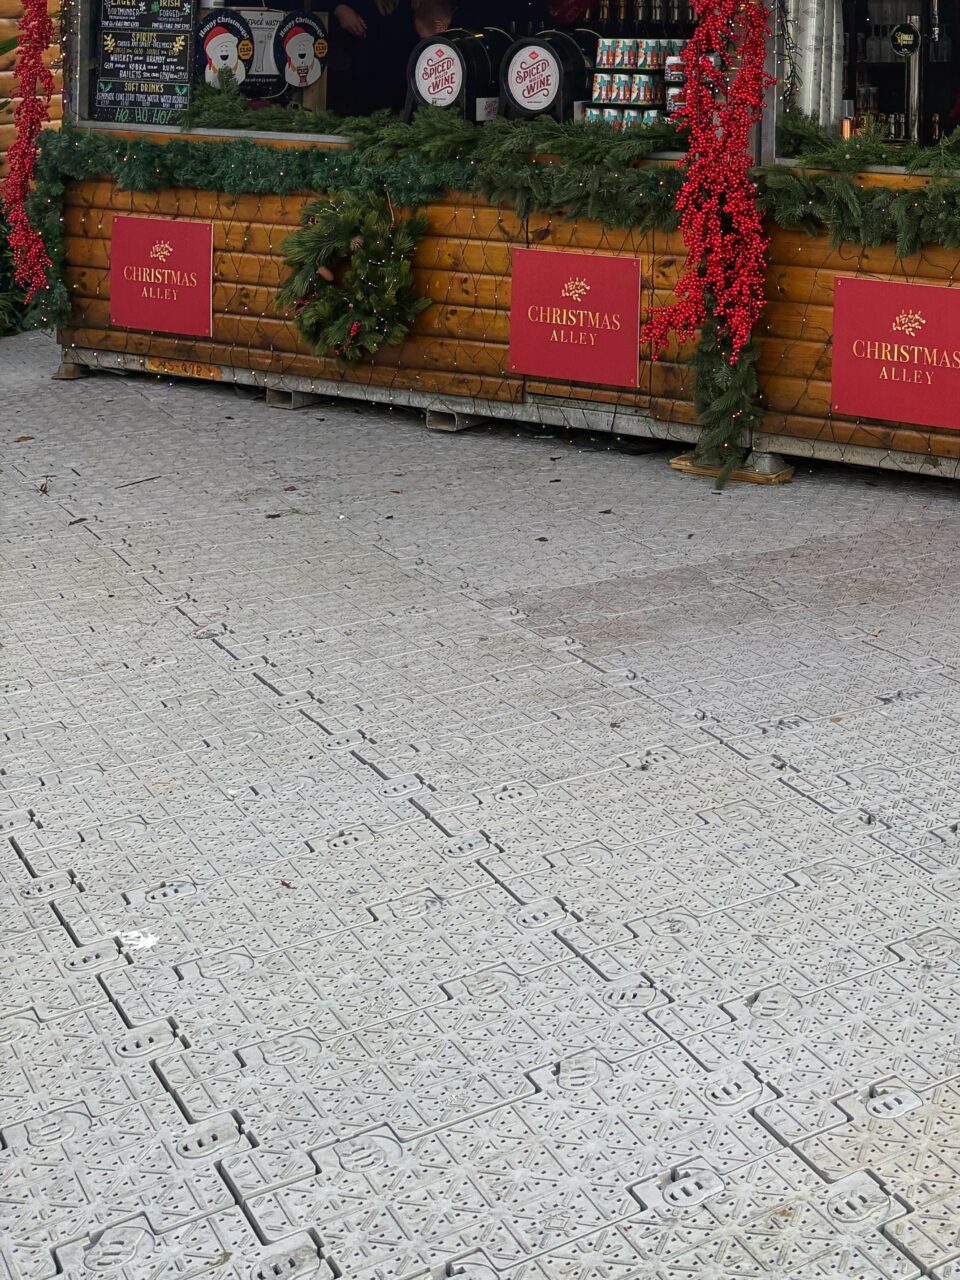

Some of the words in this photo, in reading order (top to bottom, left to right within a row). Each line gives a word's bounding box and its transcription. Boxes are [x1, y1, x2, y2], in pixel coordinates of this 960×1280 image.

[131, 32, 157, 41] SPIRITS
[199, 19, 216, 38] Happy
[110, 53, 133, 62] WHISKEY
[146, 55, 167, 64] BRANDY
[128, 62, 147, 71] VODKA
[421, 58, 455, 80] SPICED
[515, 60, 550, 84] SPICED
[124, 82, 139, 92] SOFT
[140, 83, 164, 93] DRINKS
[431, 72, 456, 93] WINE
[526, 74, 552, 95] WINE
[123, 265, 198, 288] CHRISTMAS
[141, 286, 178, 301] ALLEY
[527, 305, 621, 331] CHRISTMAS
[550, 329, 597, 346] ALLEY
[879, 366, 934, 385] ALLEY
